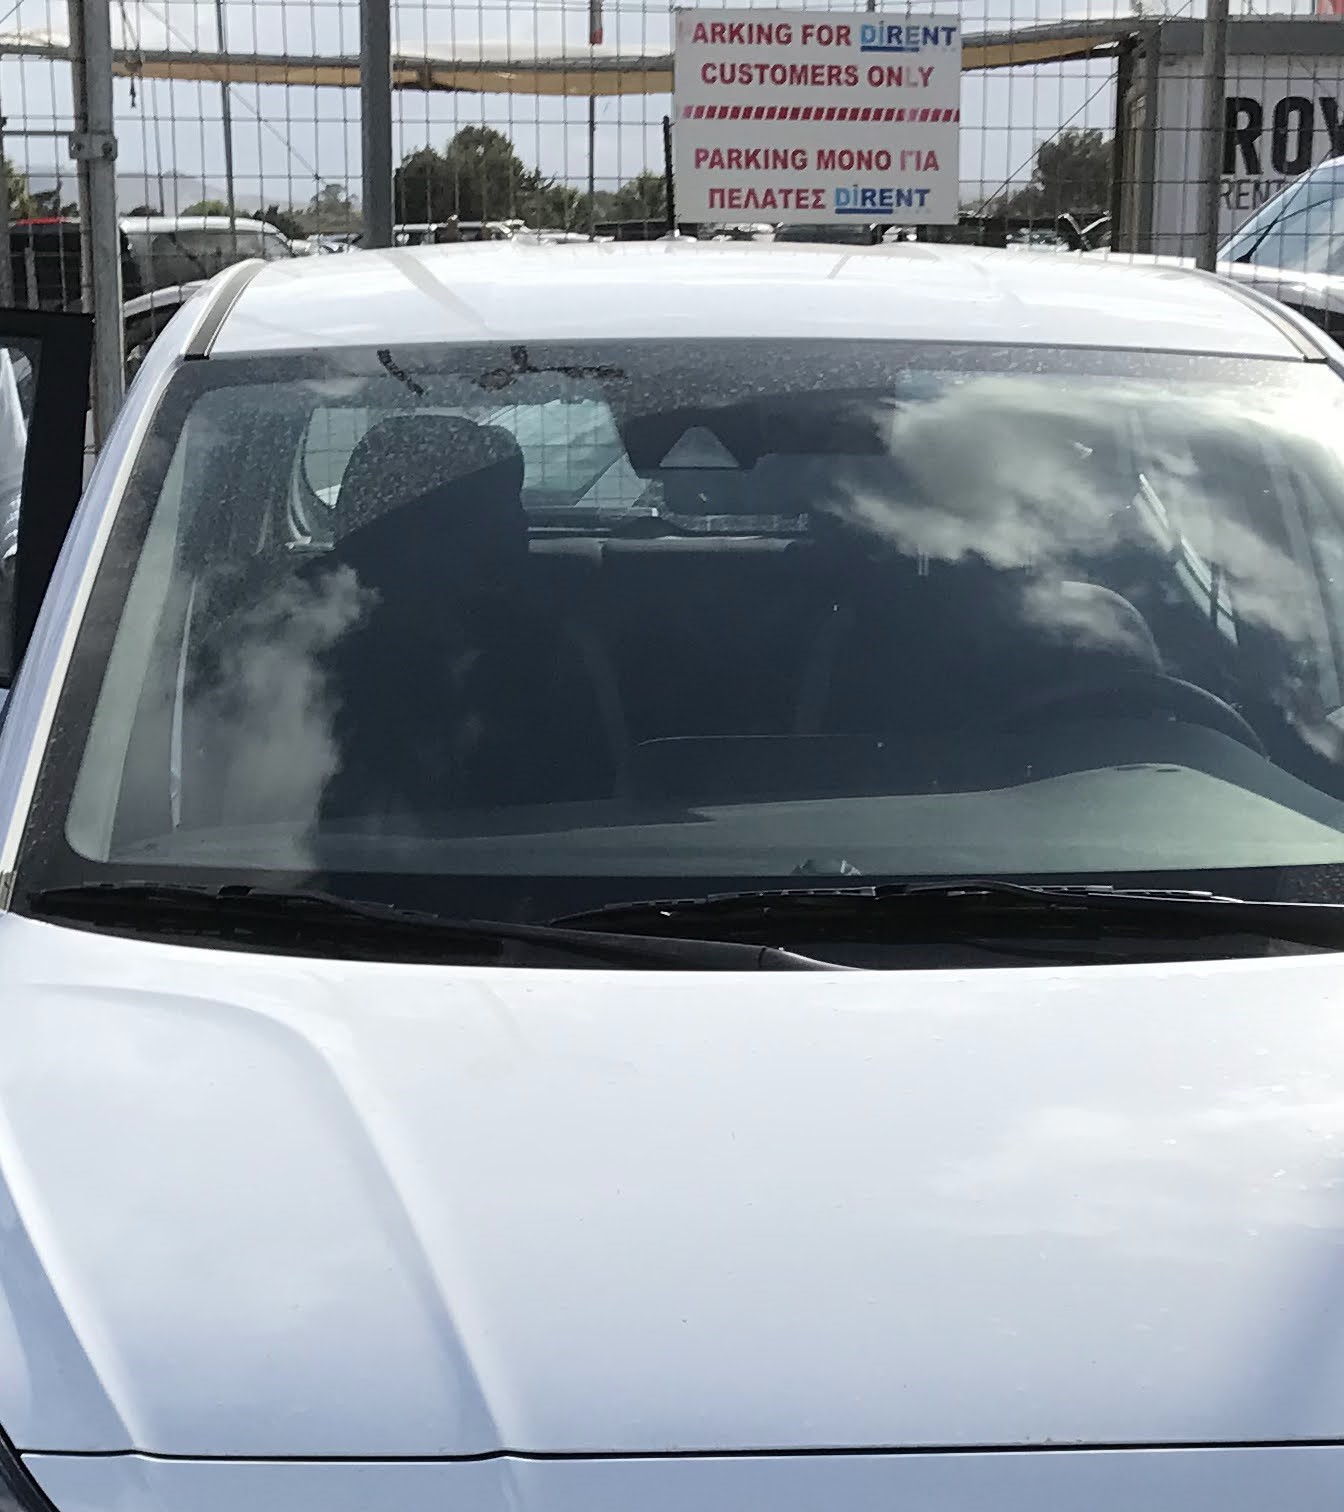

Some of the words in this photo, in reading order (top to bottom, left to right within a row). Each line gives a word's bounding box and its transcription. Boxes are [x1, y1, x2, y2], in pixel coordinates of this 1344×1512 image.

[679, 22, 793, 45] ARKING
[802, 23, 853, 46] FOR
[700, 62, 860, 87] CUSTOMERS
[867, 66, 935, 88] ONLY
[694, 148, 809, 171] PARKING
[708, 187, 826, 209] ΠΕΛΑΤΕΣ
